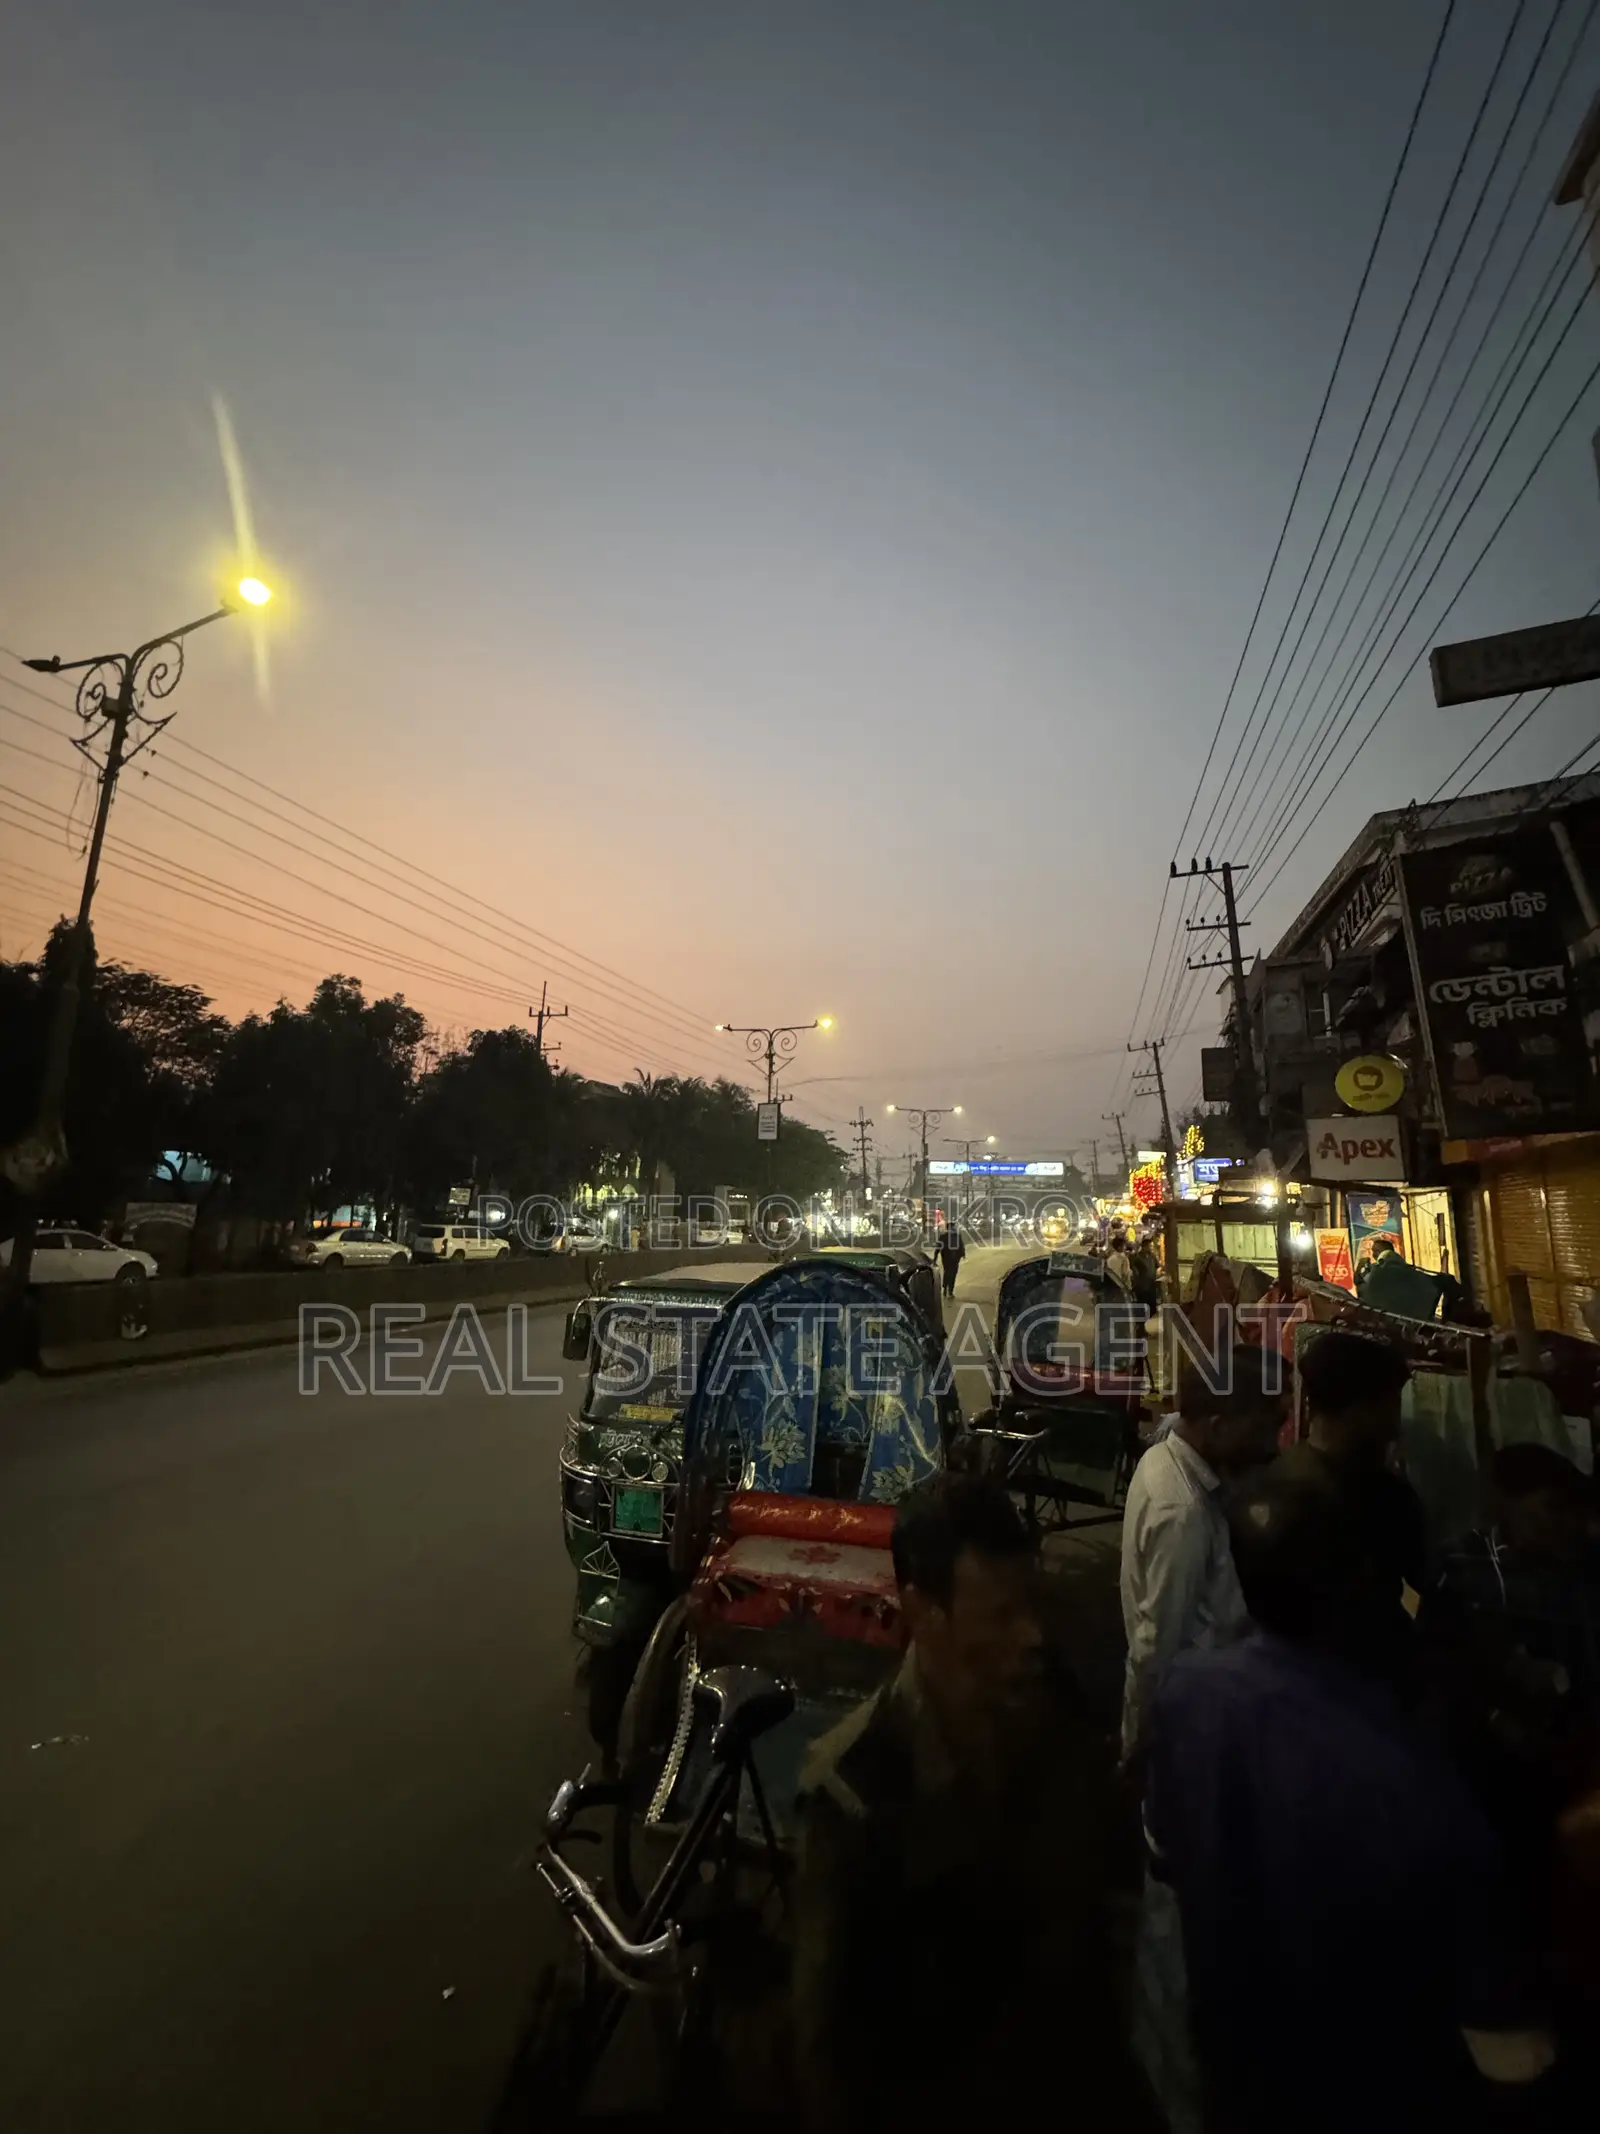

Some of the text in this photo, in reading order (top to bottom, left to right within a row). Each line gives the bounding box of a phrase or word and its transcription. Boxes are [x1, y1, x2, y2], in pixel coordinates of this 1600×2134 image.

[1420, 906, 1441, 929] দি
[1509, 891, 1548, 918] ট্রিট
[1429, 964, 1566, 1003] ডেন্টাল
[1466, 996, 1568, 1028] ক্লিনিক
[1316, 1133, 1396, 1165] Apex
